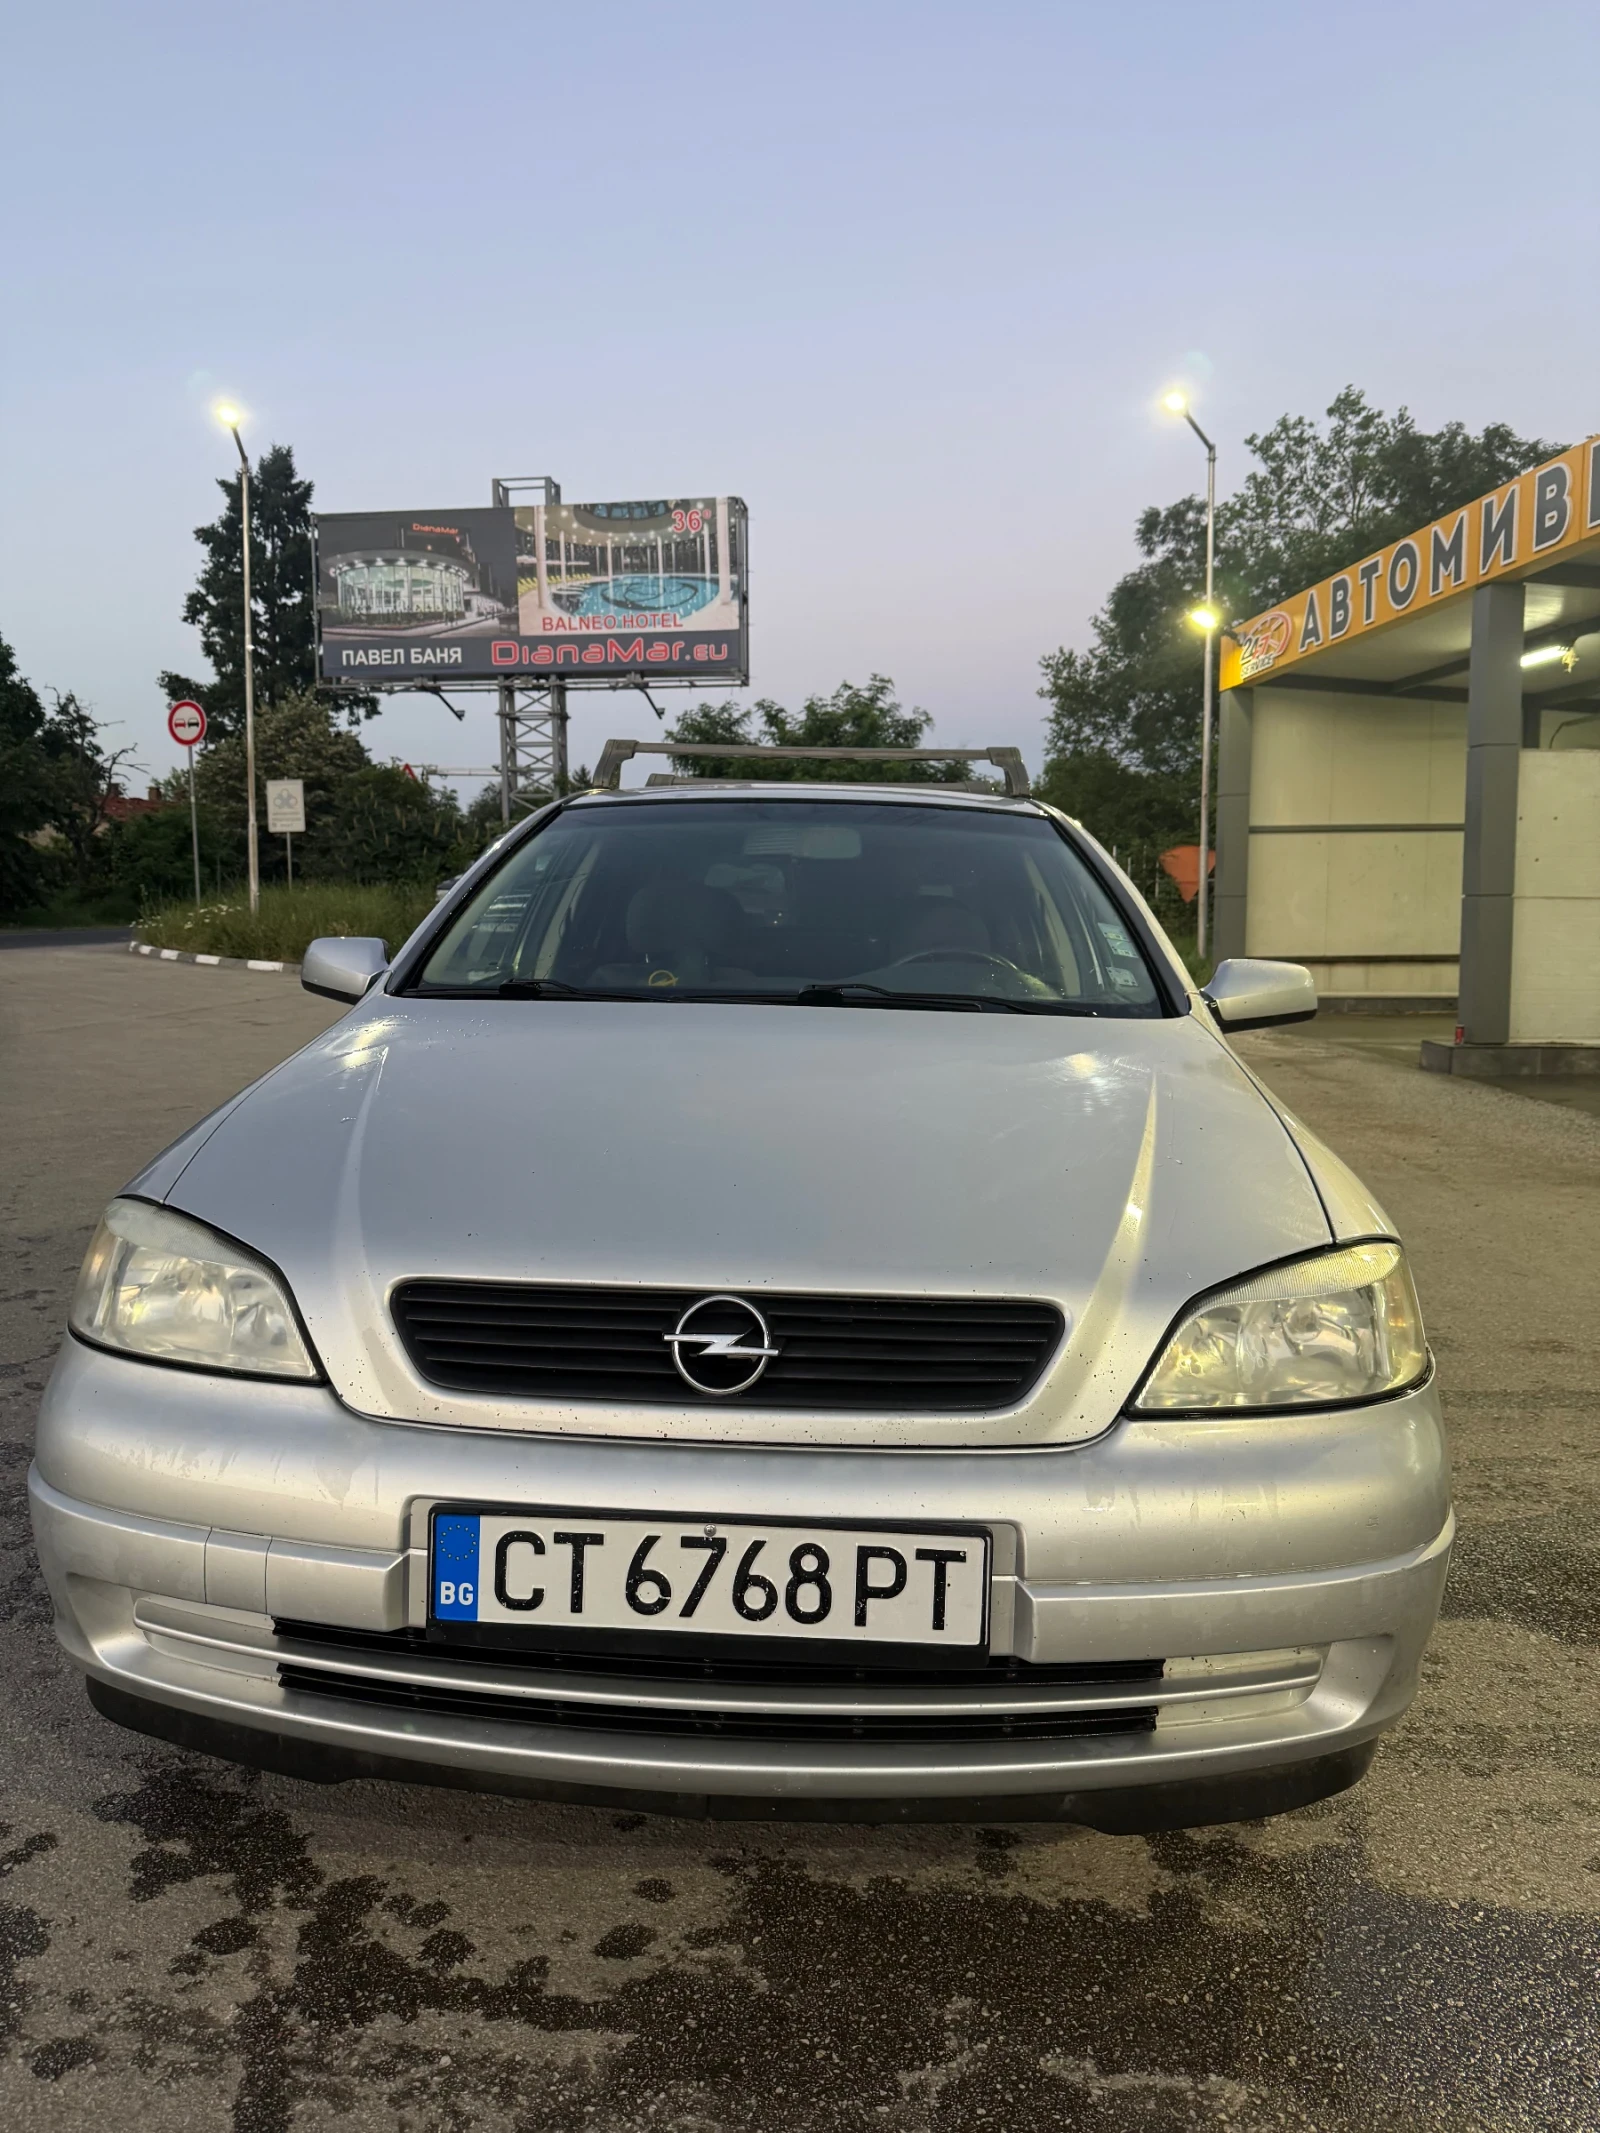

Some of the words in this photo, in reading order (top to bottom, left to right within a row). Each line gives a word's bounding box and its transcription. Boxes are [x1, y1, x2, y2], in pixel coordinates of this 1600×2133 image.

[542, 614, 617, 631] BALNEO
[622, 612, 683, 629] HOTEL
[342, 648, 405, 666] ПАВЕЛ
[410, 647, 462, 664] БАНЯ
[494, 1529, 605, 1614] CT
[624, 1534, 833, 1625] 6768
[854, 1544, 967, 1631] PT
[440, 1580, 475, 1606] BG
